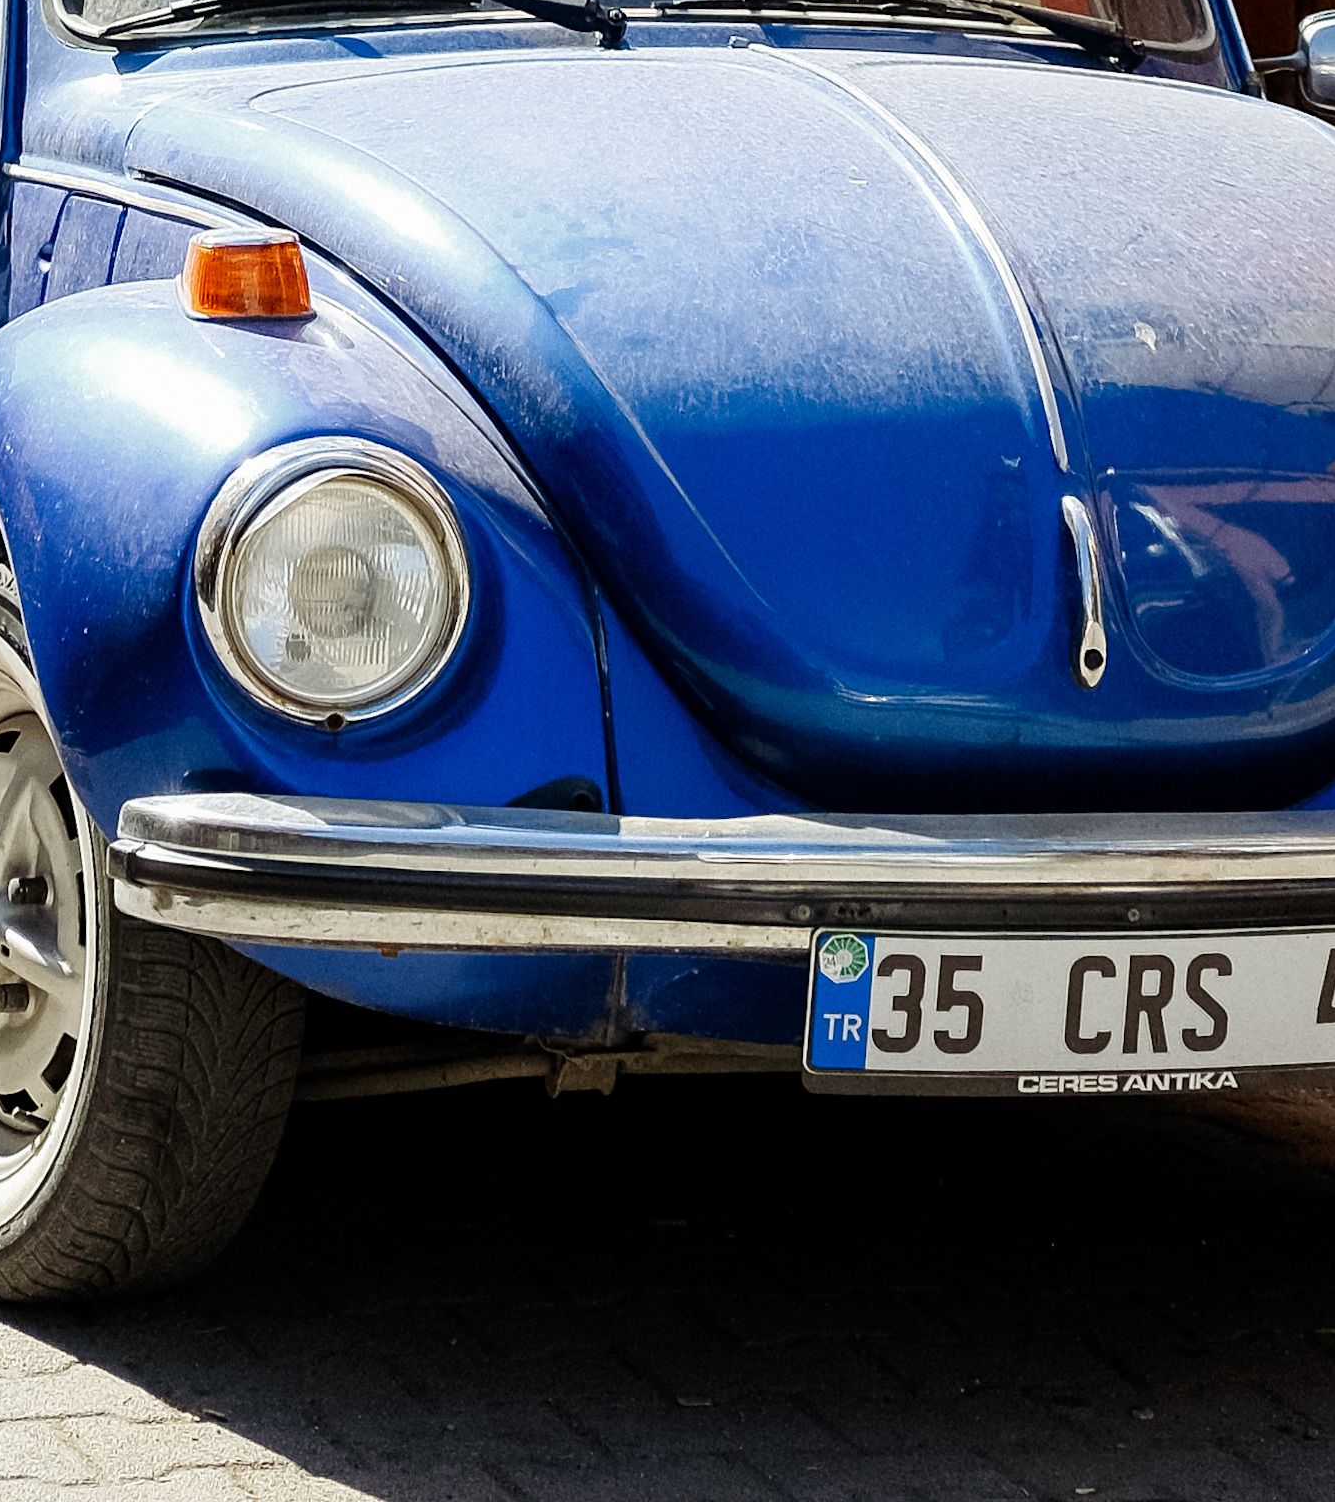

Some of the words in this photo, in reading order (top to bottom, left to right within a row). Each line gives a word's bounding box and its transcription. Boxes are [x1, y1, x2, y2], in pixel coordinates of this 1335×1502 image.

[871, 954, 984, 1054] 35
[1065, 953, 1233, 1054] CRS
[823, 1013, 862, 1042] TR
[1018, 1075, 1118, 1093] CERES
[1123, 1071, 1239, 1091] ANTIKA
